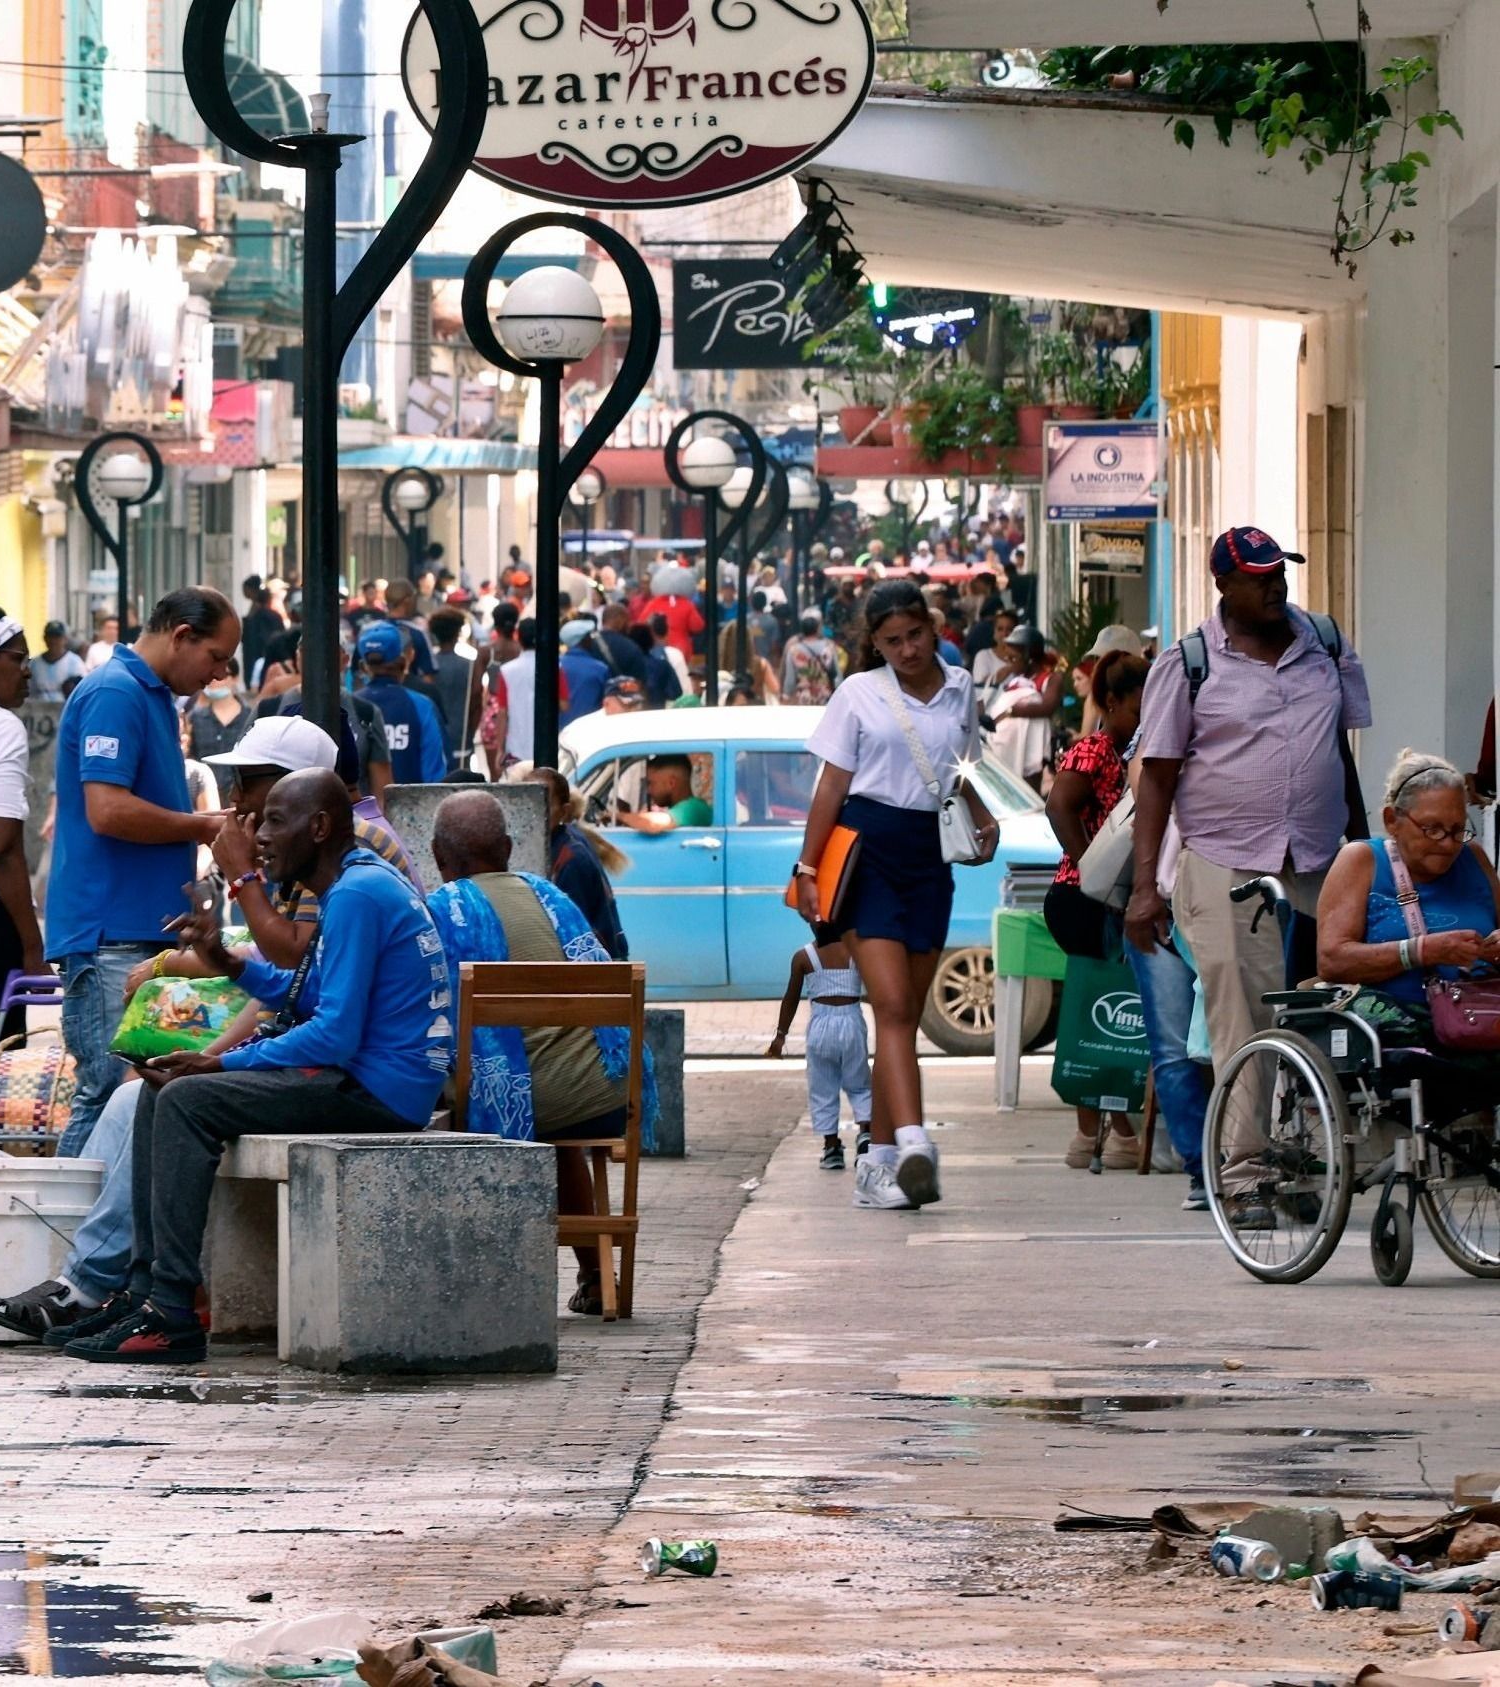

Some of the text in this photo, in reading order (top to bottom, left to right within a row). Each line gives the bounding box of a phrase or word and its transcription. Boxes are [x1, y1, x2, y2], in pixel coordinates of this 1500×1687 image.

[430, 56, 848, 108] azar Francés
[557, 112, 719, 131] cafetería
[1070, 472, 1145, 483] LA INDUSTRIA
[1096, 999, 1145, 1027] Vima
